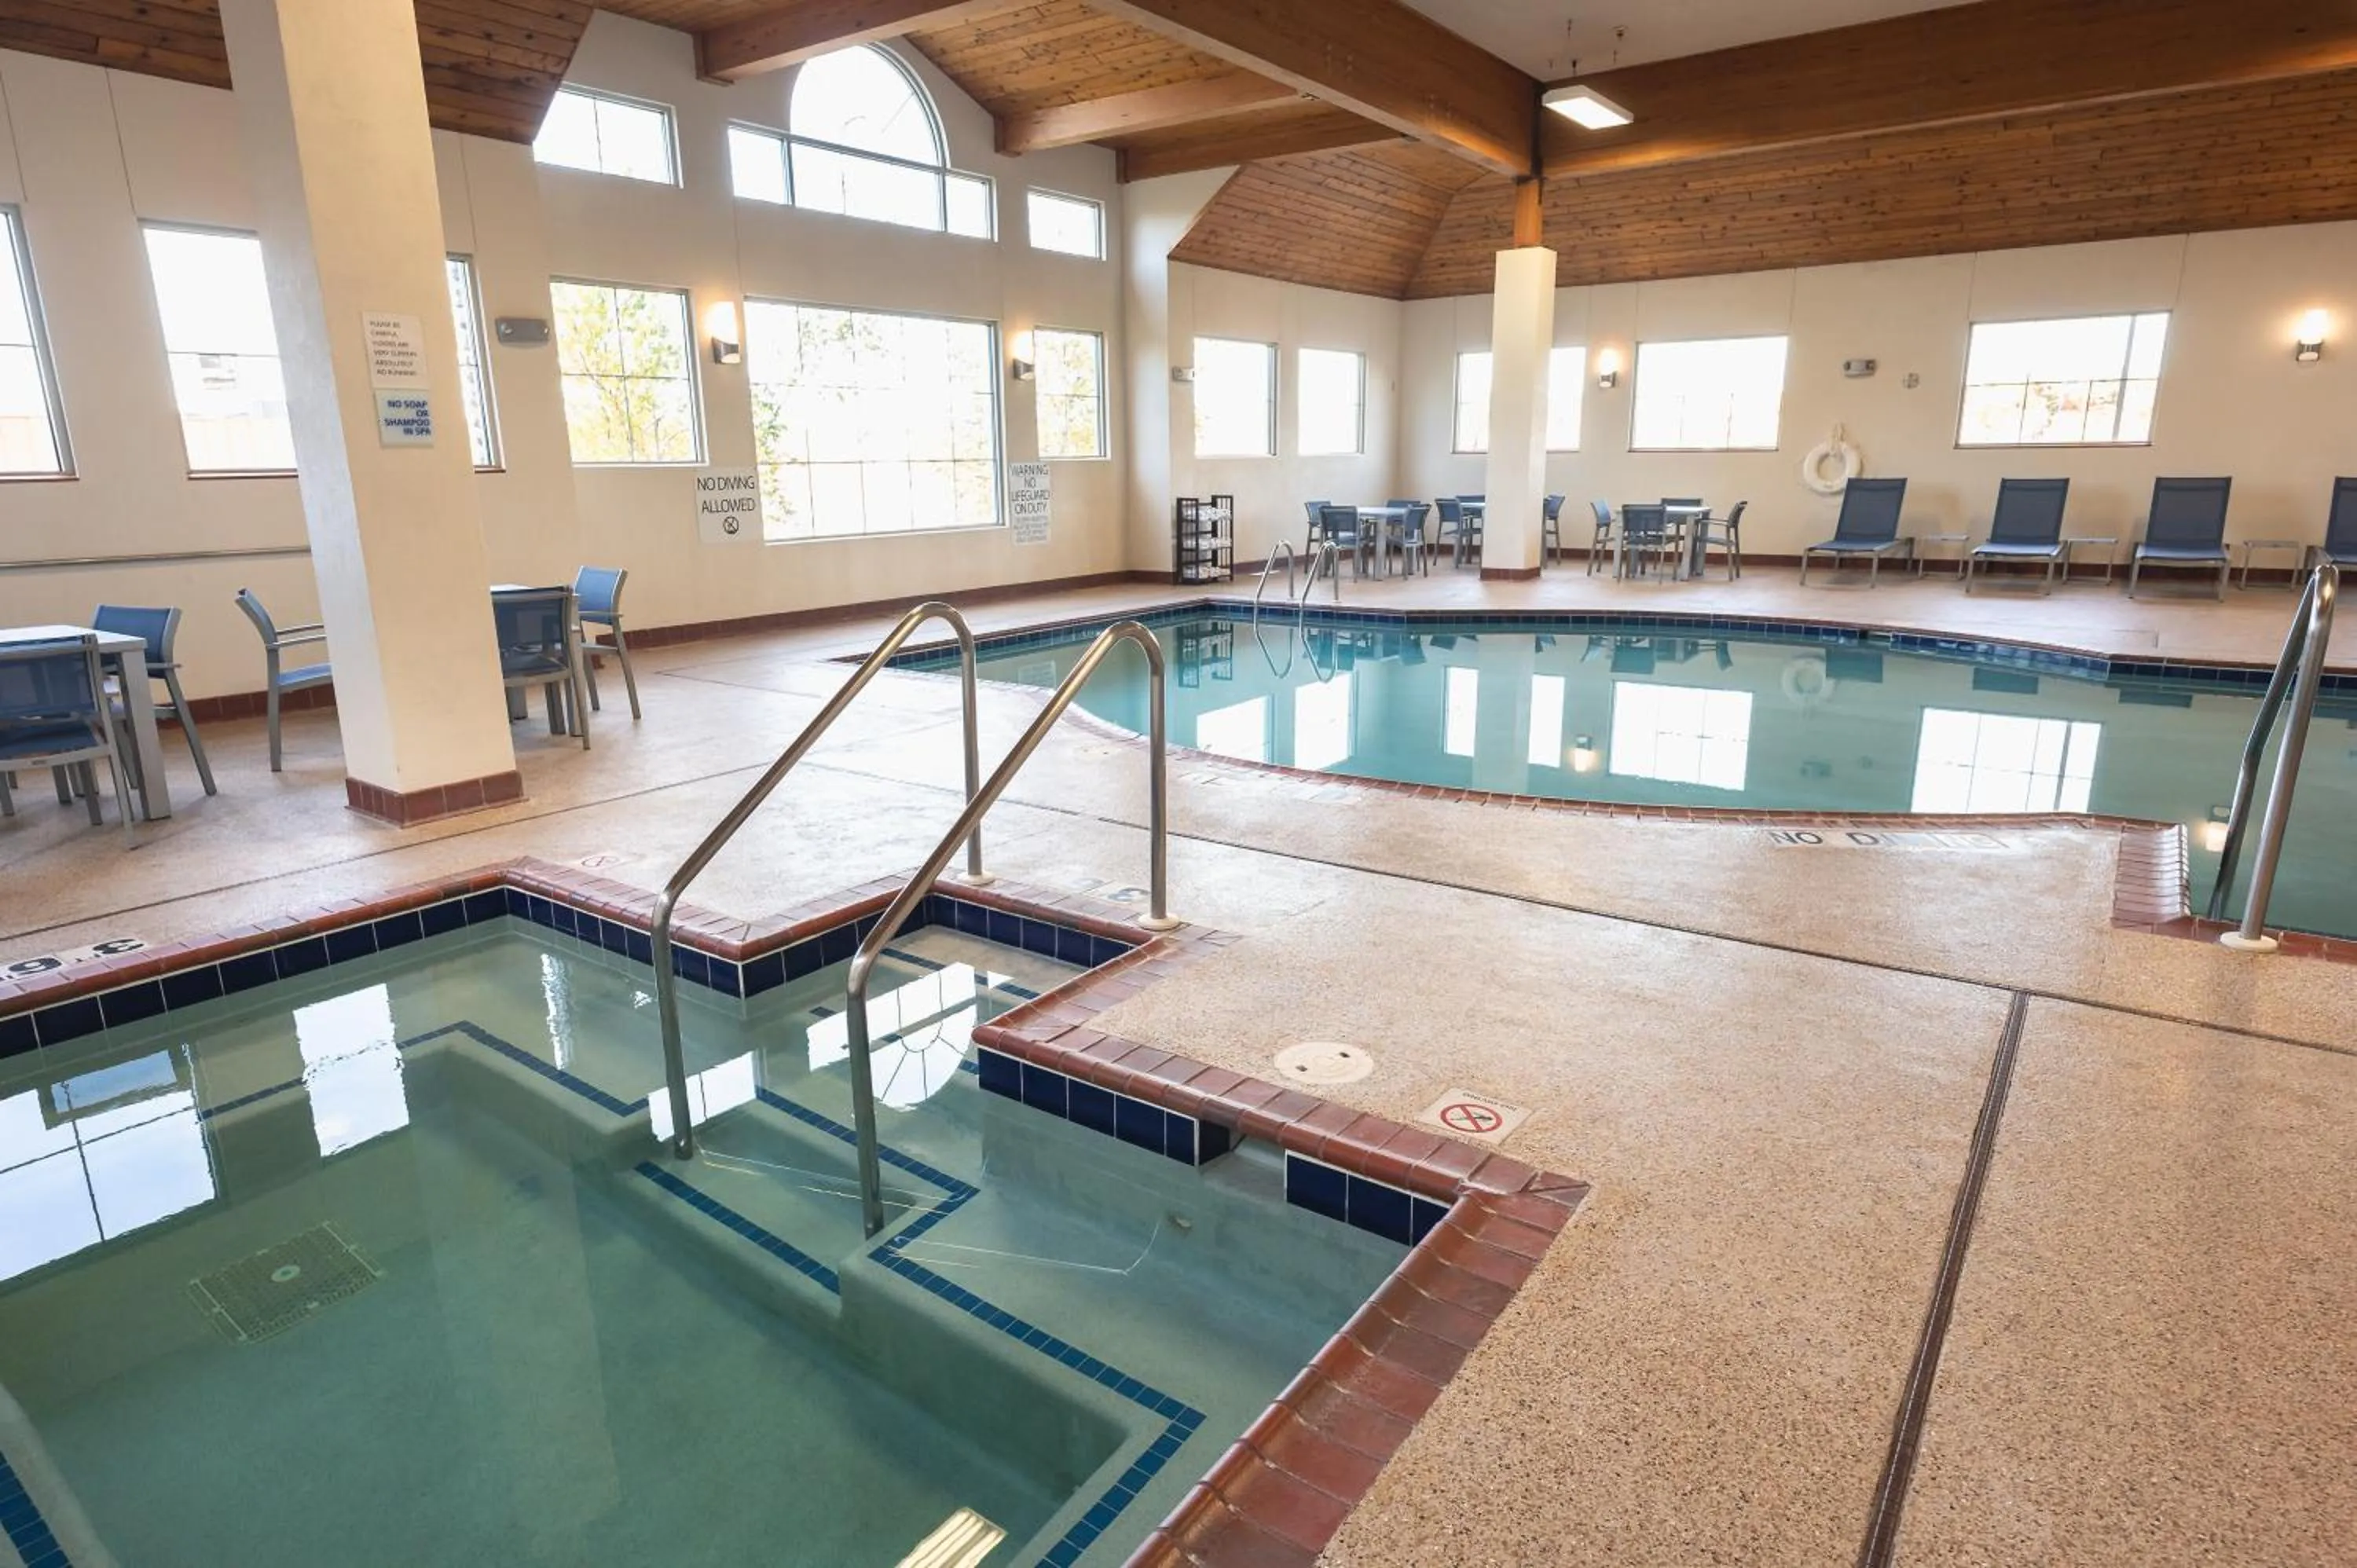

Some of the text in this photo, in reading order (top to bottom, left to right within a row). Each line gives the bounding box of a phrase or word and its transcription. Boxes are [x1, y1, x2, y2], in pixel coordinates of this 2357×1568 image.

[387, 400, 427, 408] NO SOAP
[384, 418, 430, 427] SHAMPOO
[415, 427, 431, 436] SPA
[1010, 464, 1049, 477] WARNING
[697, 475, 755, 491] NO DIVING
[1024, 477, 1036, 488] NO
[1011, 489, 1050, 501] LIFEGUARD
[702, 497, 756, 514] ALLOWED
[1015, 501, 1048, 515] ON DUTY
[1770, 832, 1824, 845] NO
